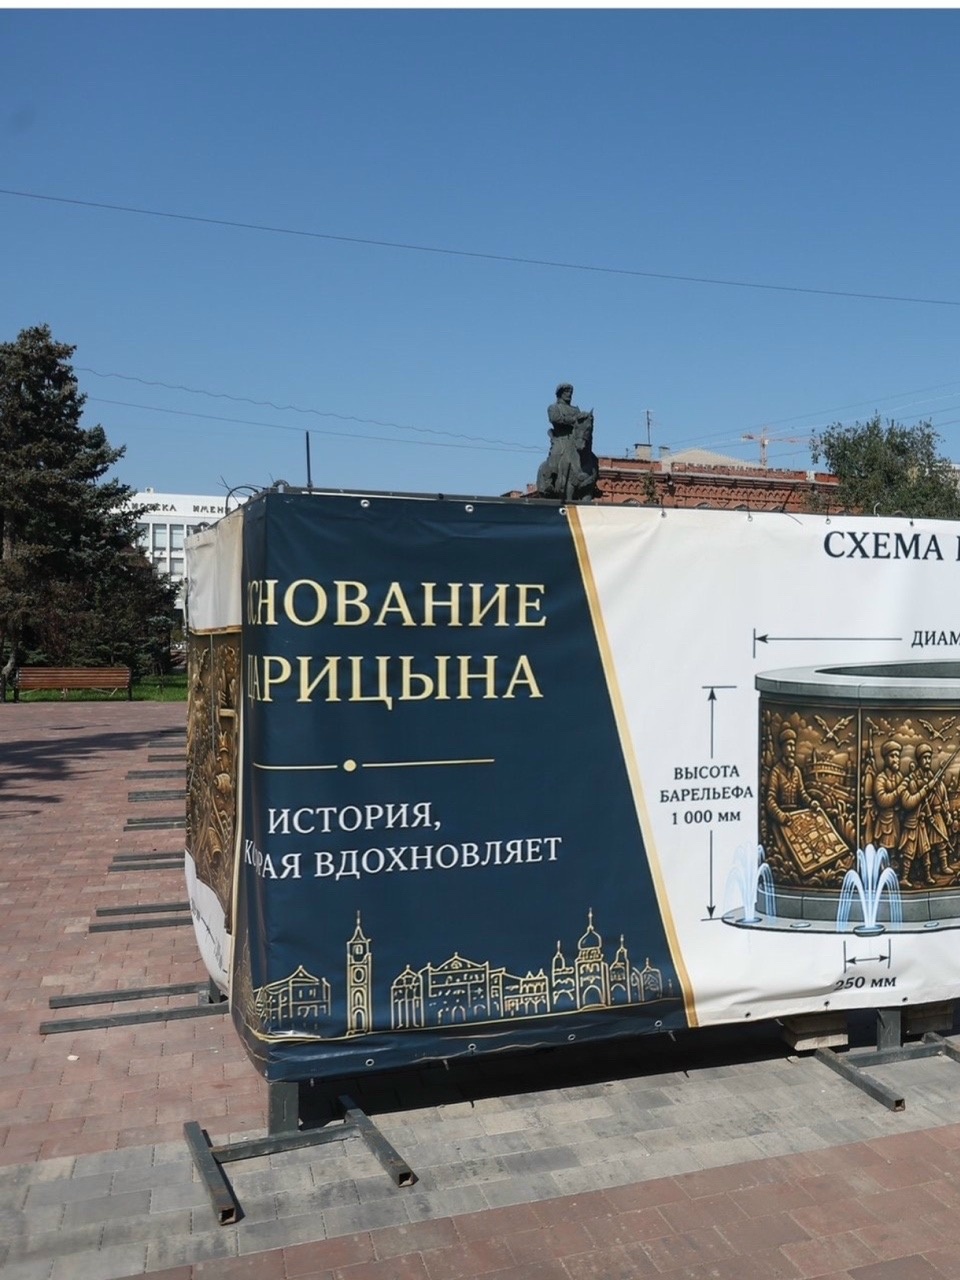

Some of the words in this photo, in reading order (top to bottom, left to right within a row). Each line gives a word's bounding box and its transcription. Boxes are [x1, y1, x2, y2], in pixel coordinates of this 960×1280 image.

[823, 531, 941, 562] СХЕМА
[248, 579, 546, 626] ОСНОВАНИЕ
[248, 655, 543, 710] ЦАРИЦЫНА
[674, 765, 739, 780] ВЫСОТА
[660, 786, 753, 803] БАРЕЛЬЕФА
[269, 802, 440, 834] ИСТОРИЯ,
[673, 812, 677, 825] 1
[684, 810, 712, 824] 000
[718, 811, 740, 822] мм
[314, 837, 562, 880] ВДОХНОВЛЯЕТ
[831, 976, 866, 993] 250
[871, 977, 896, 987] мм
